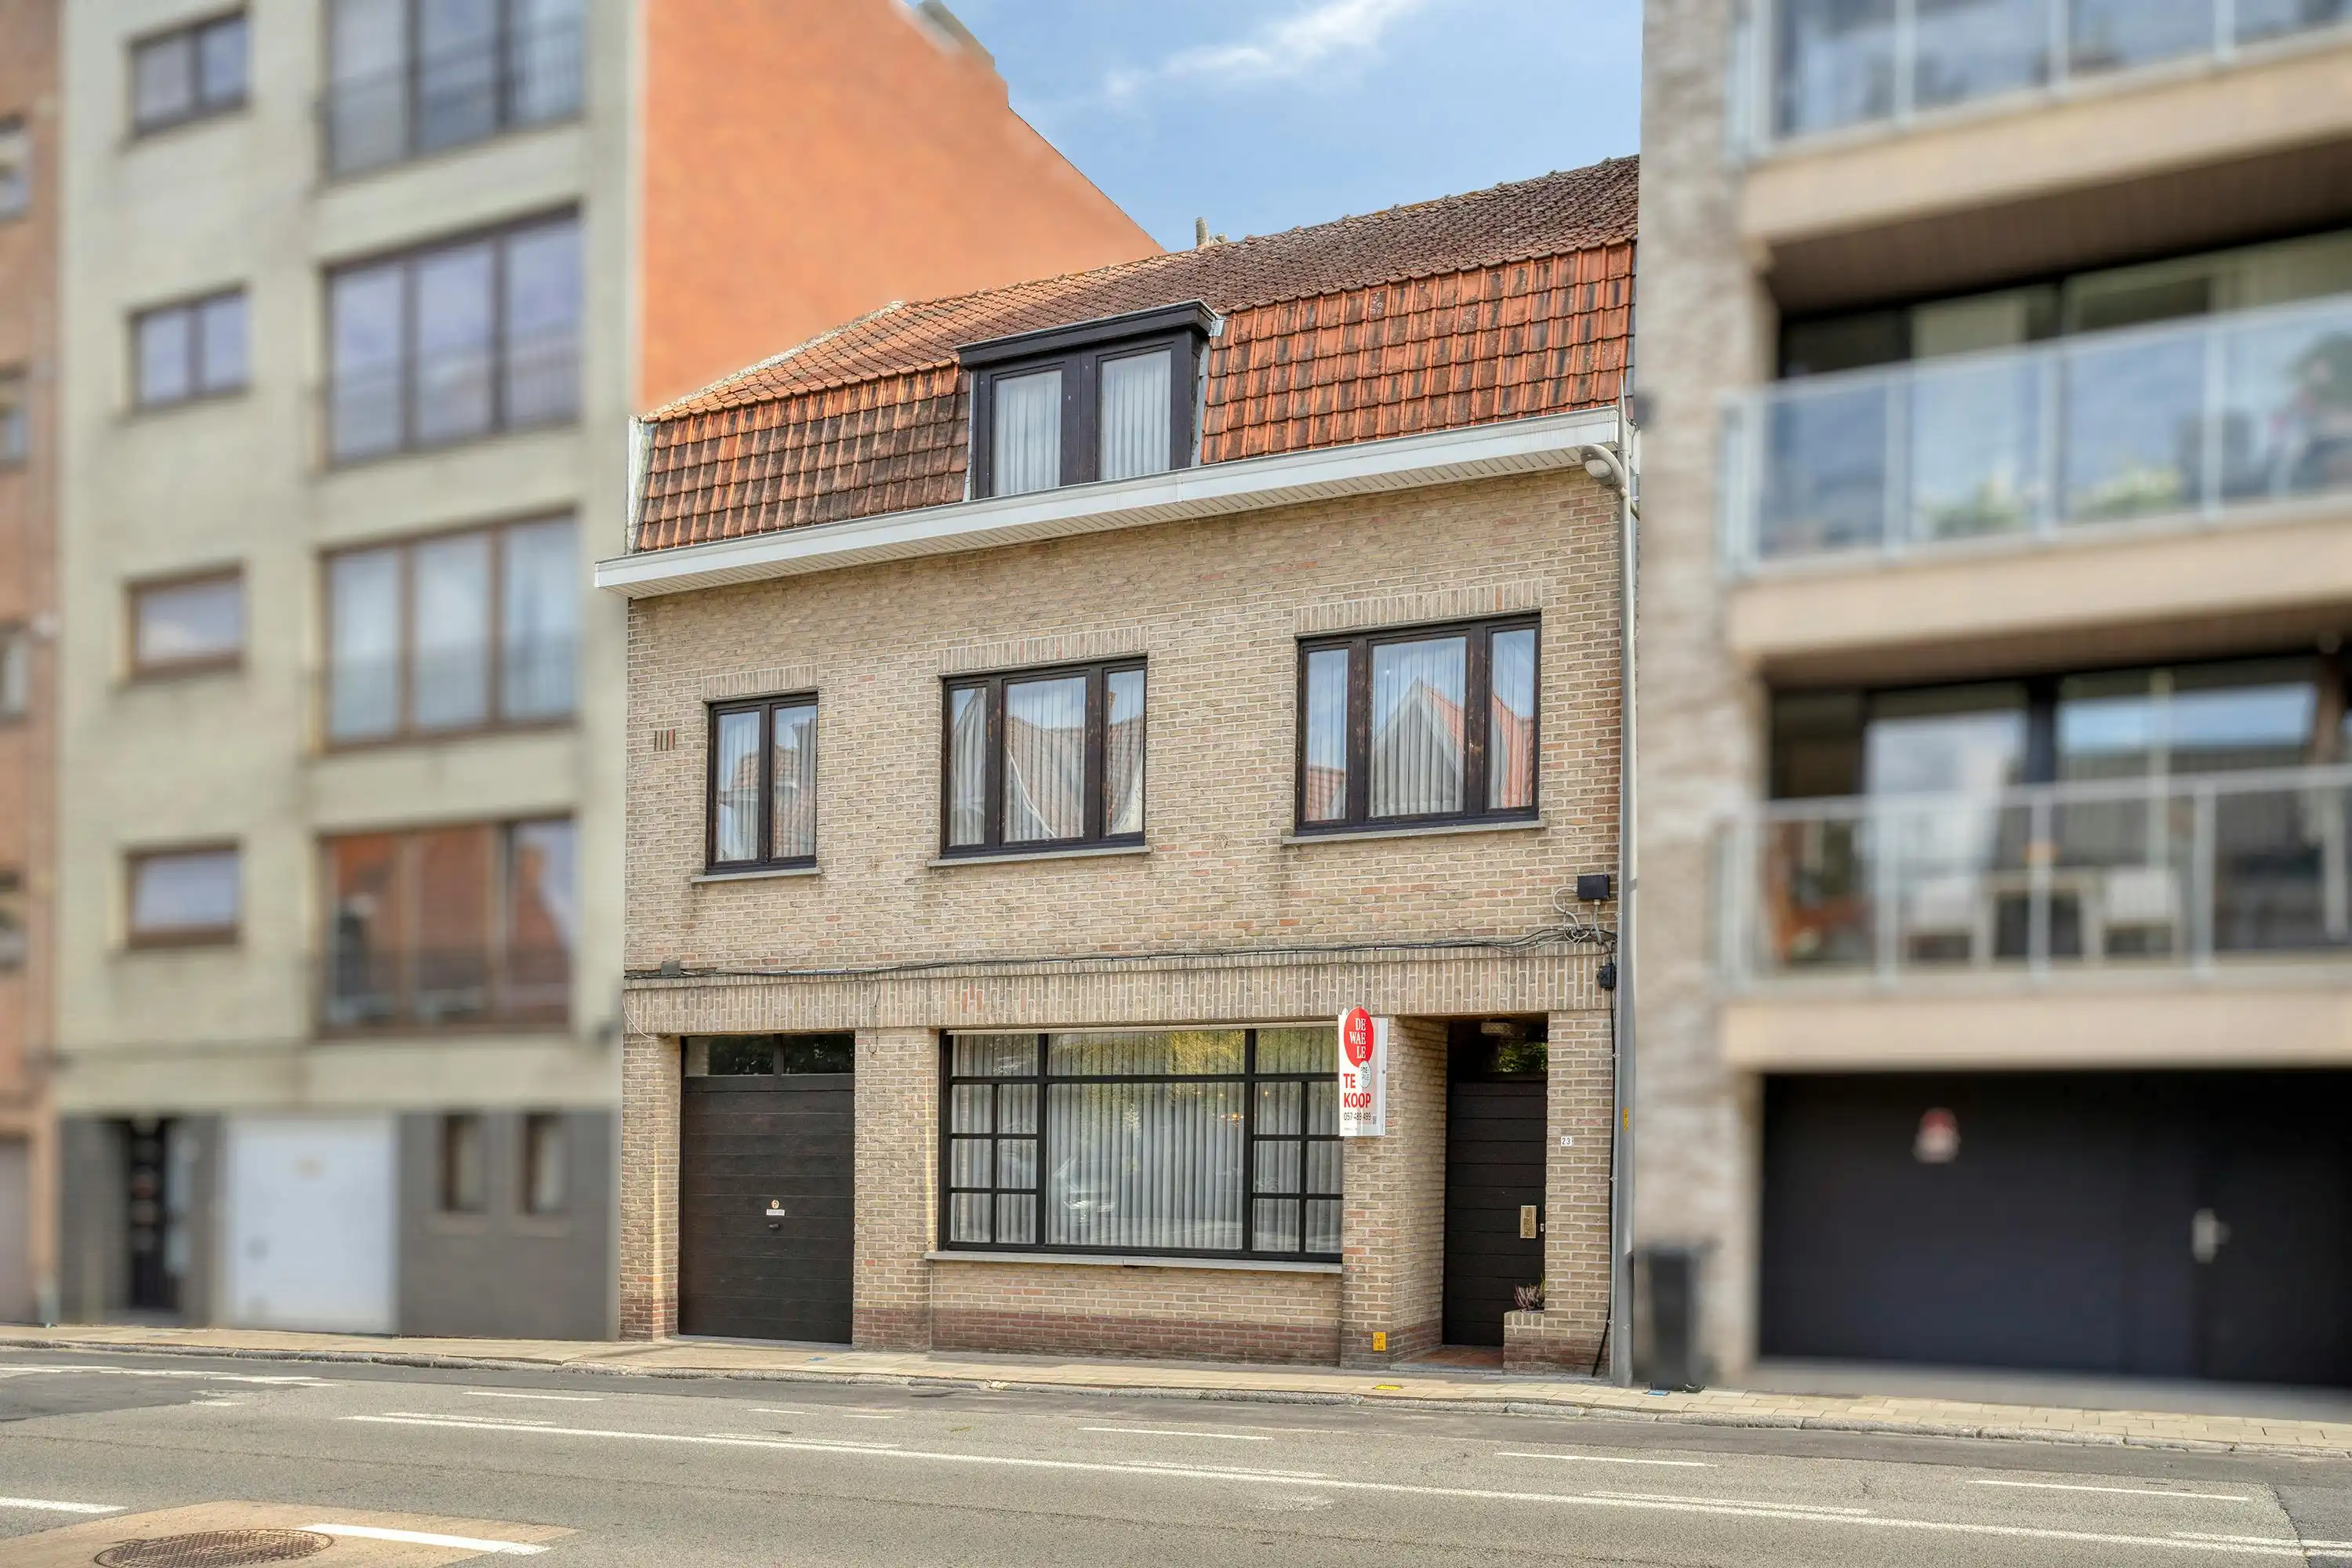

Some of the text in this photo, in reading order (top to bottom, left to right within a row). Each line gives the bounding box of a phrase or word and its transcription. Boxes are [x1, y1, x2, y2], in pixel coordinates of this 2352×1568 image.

[1355, 1018, 1366, 1031] DE
[1349, 1031, 1366, 1044] WAE
[1356, 1046, 1366, 1058] LE
[1343, 1073, 1356, 1089] TE
[1344, 1092, 1371, 1108] KOOP
